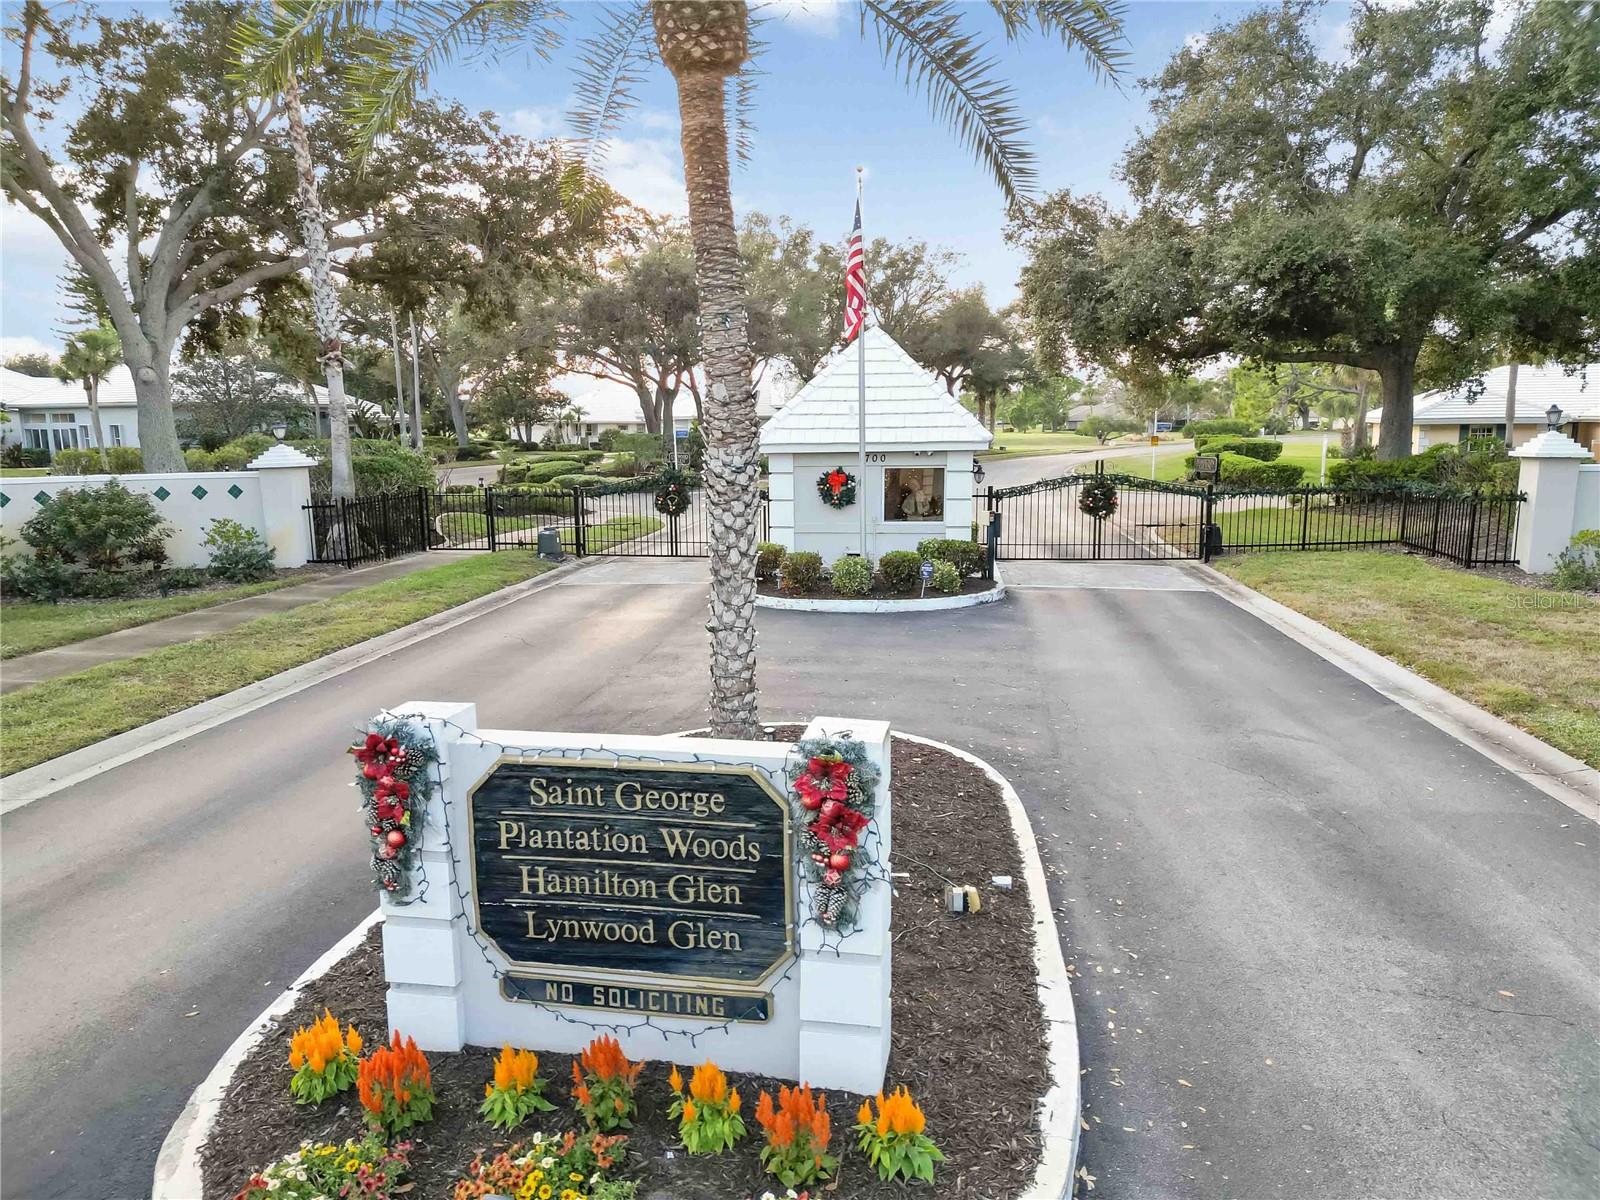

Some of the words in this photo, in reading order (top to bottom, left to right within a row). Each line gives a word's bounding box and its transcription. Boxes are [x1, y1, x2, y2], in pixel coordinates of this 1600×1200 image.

[529, 777, 606, 807] Saint
[615, 781, 726, 817] George
[496, 820, 649, 854] Plantation
[660, 827, 761, 863] Woods
[519, 865, 658, 899] Hamilton
[667, 874, 743, 905] Glen
[524, 911, 657, 944] Lynwood
[667, 919, 742, 951] Glen
[545, 982, 573, 1003] NO
[593, 986, 725, 1017] SOLICITING
